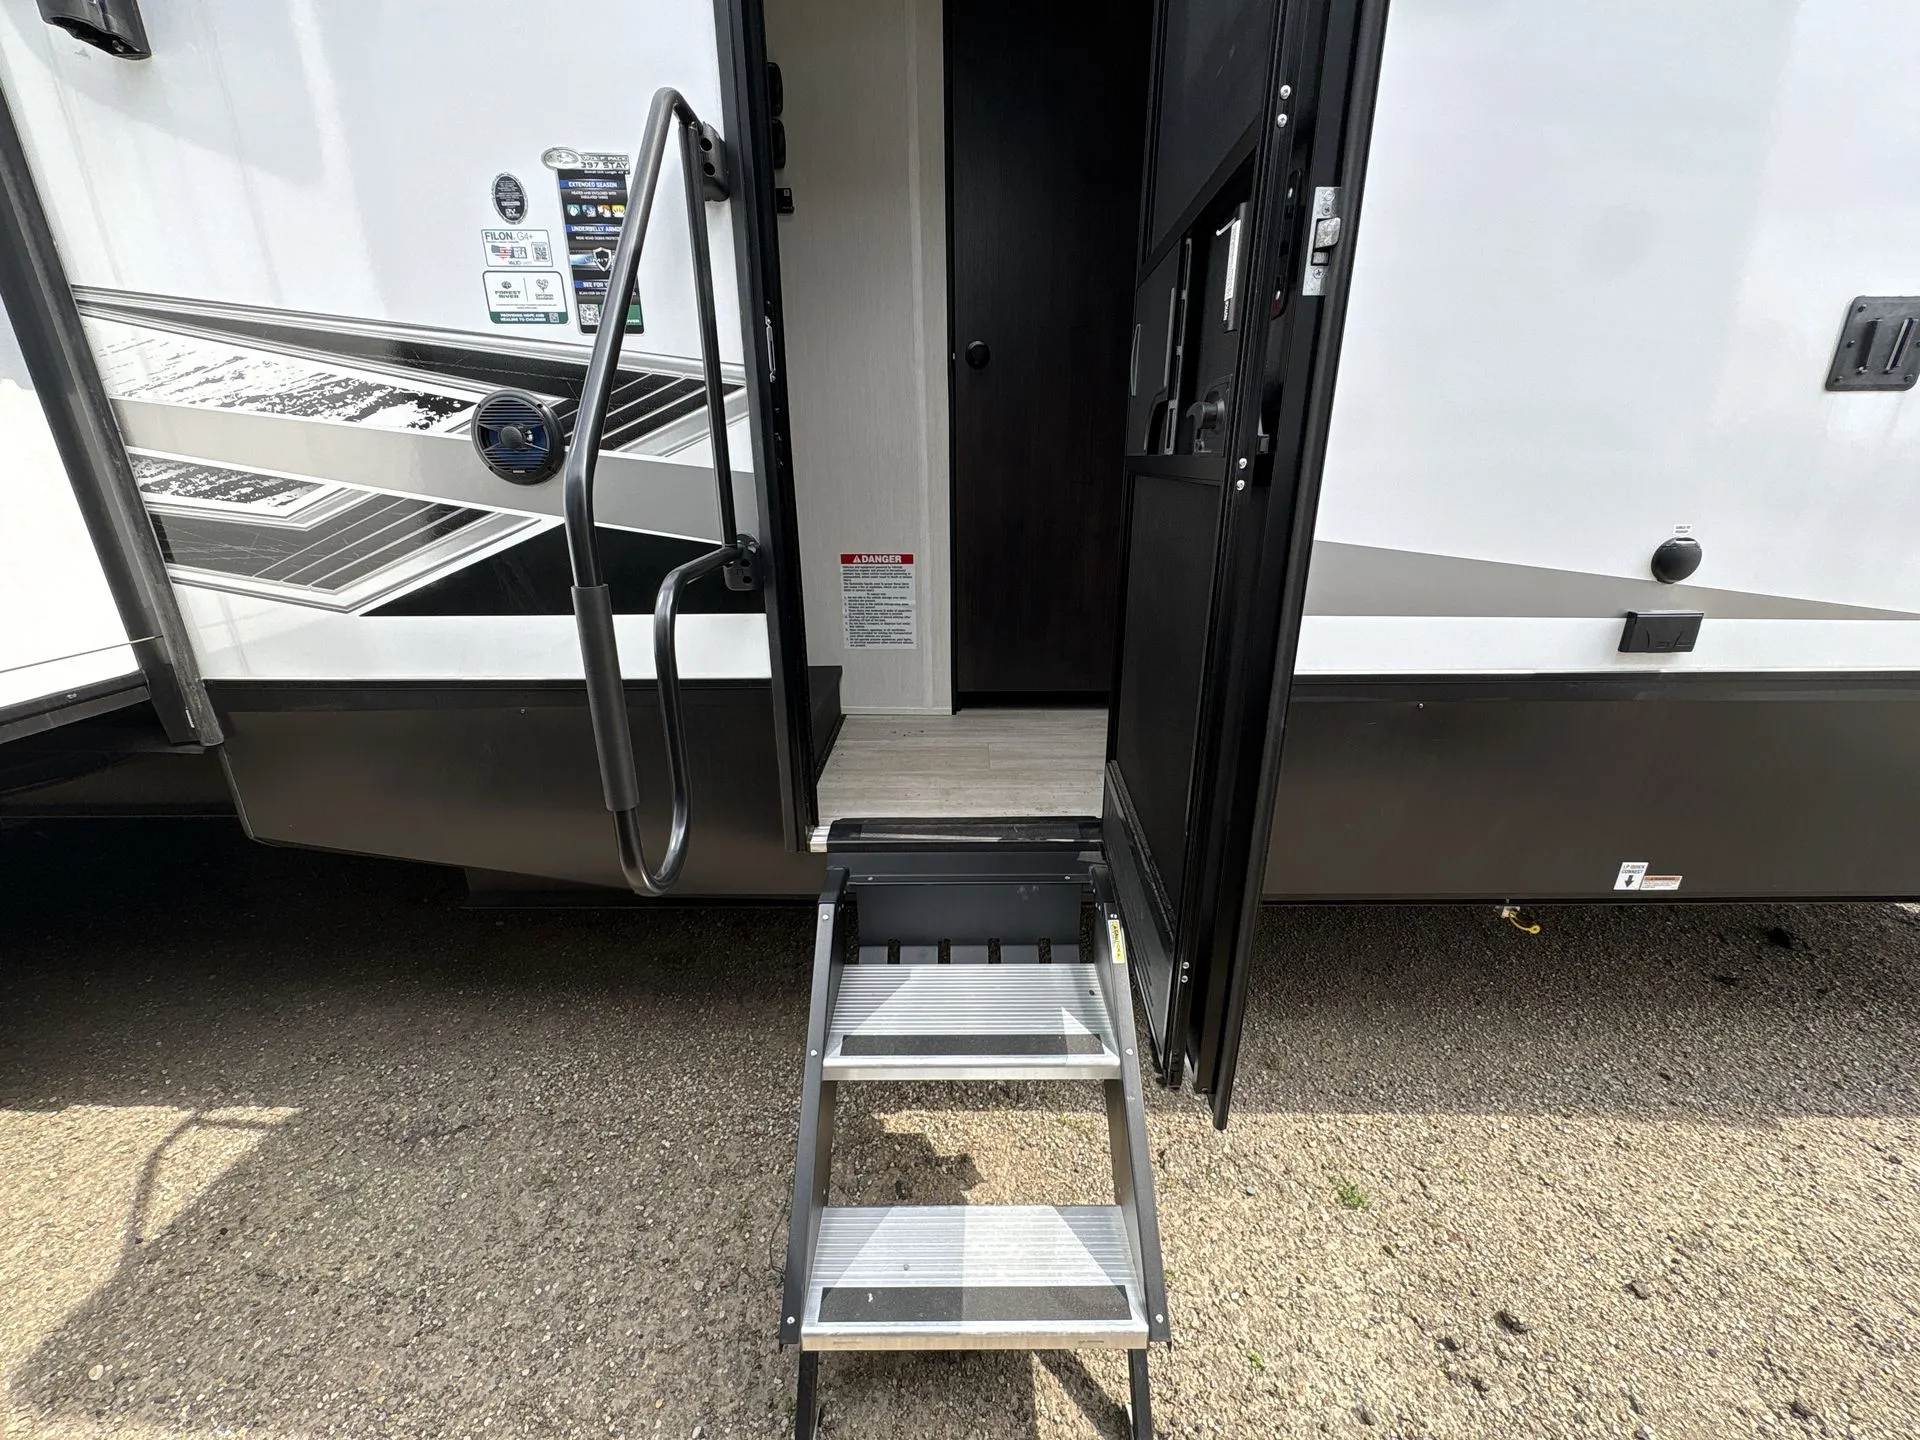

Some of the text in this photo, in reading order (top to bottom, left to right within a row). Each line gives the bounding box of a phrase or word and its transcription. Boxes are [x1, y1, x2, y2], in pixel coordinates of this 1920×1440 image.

[580, 161, 628, 169] 397 STAY
[861, 555, 902, 563] DANGER
